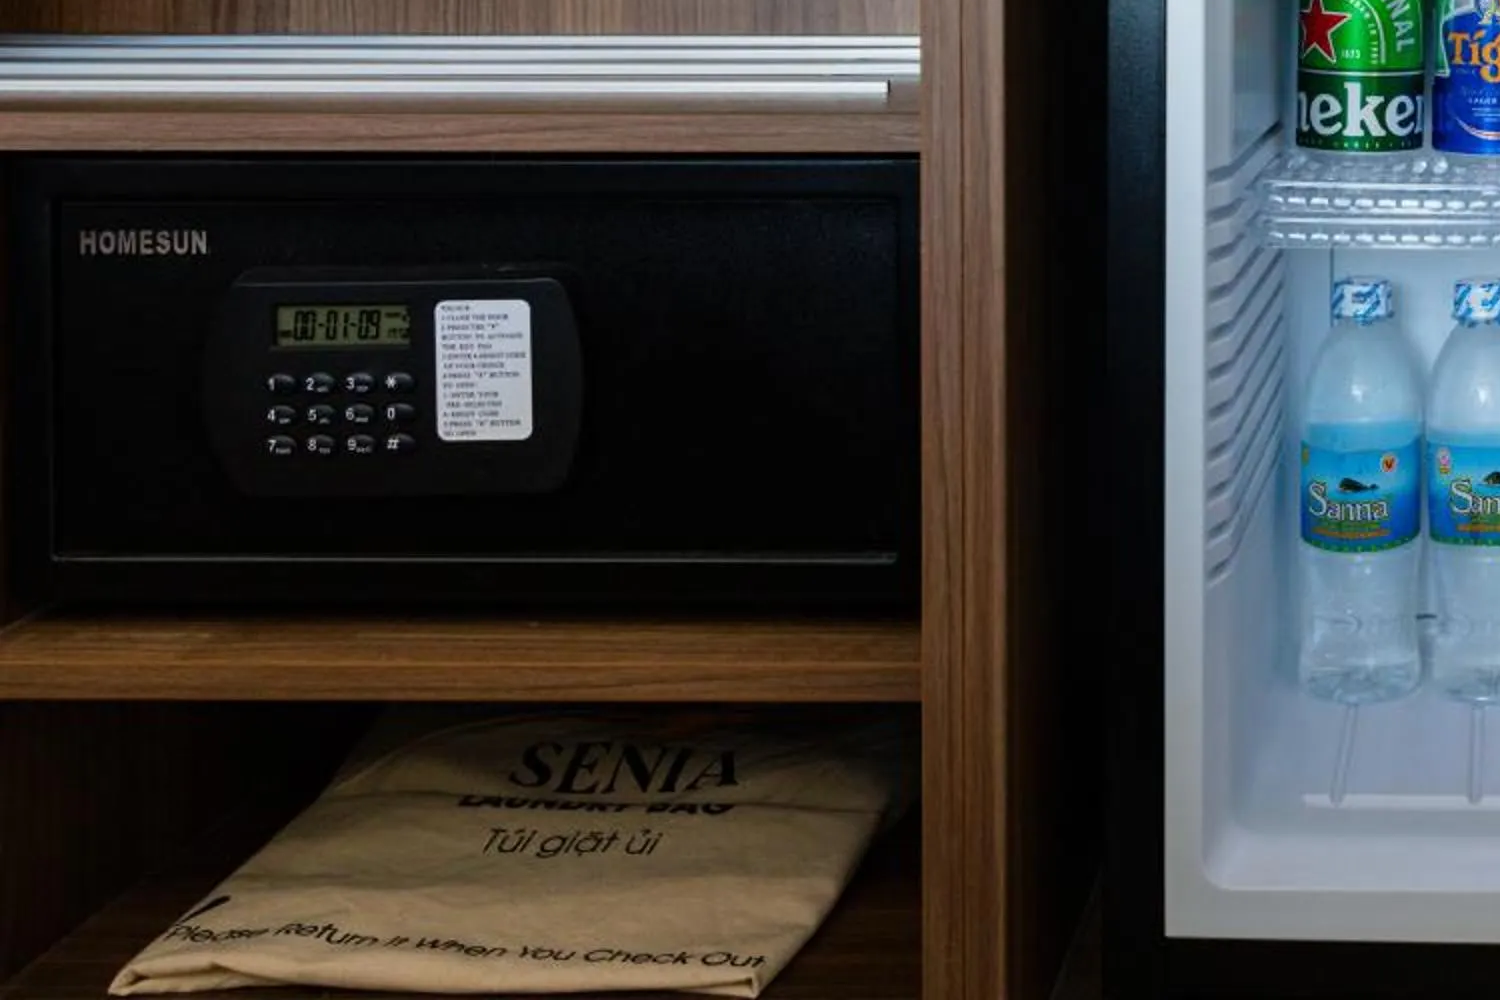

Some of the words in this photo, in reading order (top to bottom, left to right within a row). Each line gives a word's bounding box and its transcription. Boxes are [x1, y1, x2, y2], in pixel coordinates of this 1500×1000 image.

[79, 228, 208, 256] HOMESUN
[306, 376, 316, 391] 2
[345, 376, 356, 391] 3
[267, 408, 277, 422] 4
[308, 408, 318, 422] 5
[345, 407, 356, 422] 6
[268, 439, 278, 454] 7
[307, 438, 318, 452] 8
[347, 438, 358, 452] 9
[1308, 481, 1389, 521] Sanna
[509, 740, 739, 795] SENIA
[273, 922, 379, 945] Return
[415, 937, 508, 958] When
[519, 945, 577, 962] You
[583, 948, 690, 966] Check
[701, 951, 766, 968] Out
